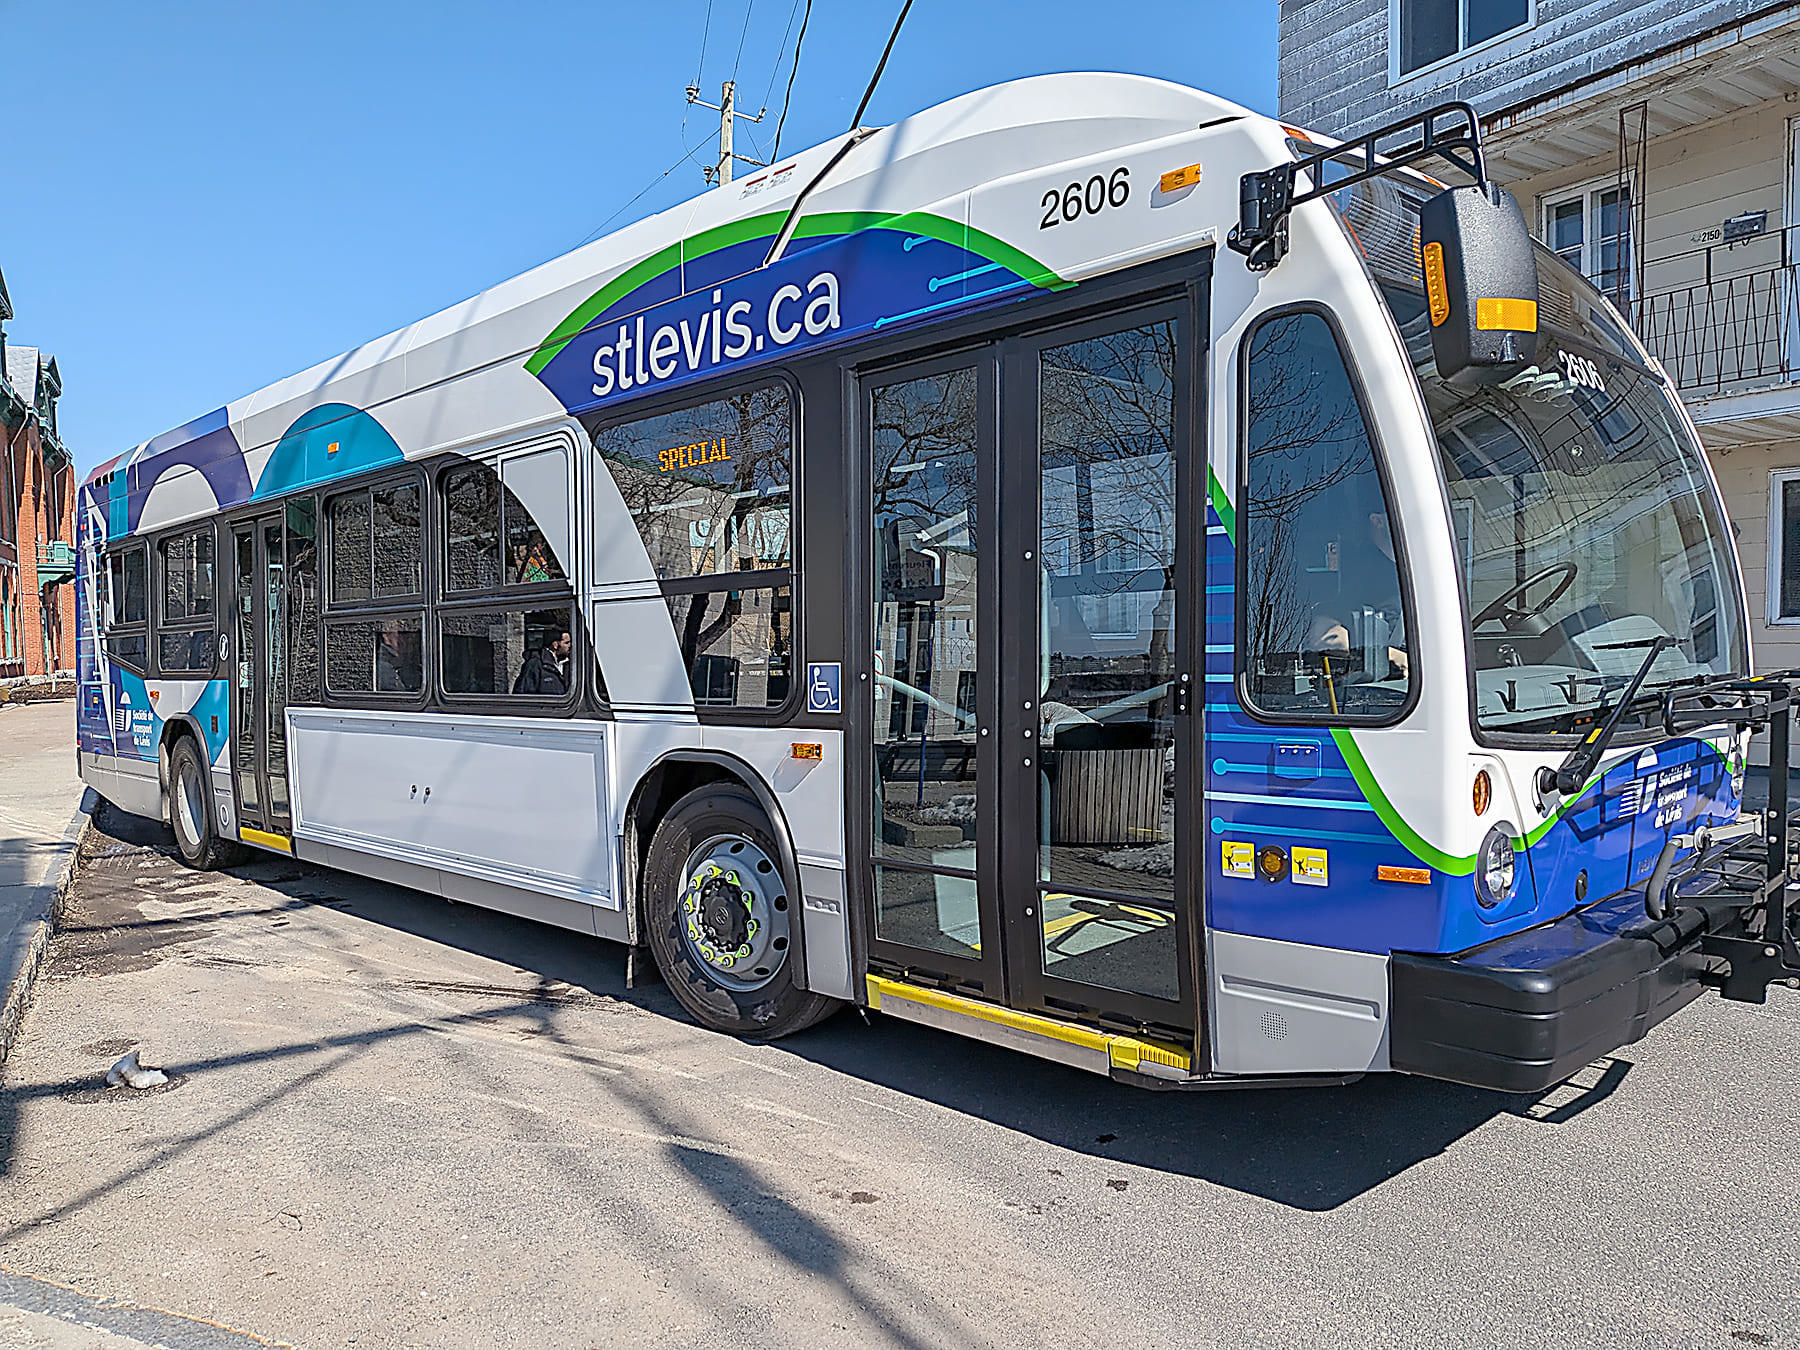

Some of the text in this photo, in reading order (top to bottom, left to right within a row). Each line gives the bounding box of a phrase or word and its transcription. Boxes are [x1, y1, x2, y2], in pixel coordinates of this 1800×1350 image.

[1040, 167, 1130, 230] 2606
[1701, 229, 1720, 242] 2150
[592, 272, 841, 397] stlevis.ca
[1558, 349, 1606, 392] 2606
[657, 437, 732, 472] SPECIAL
